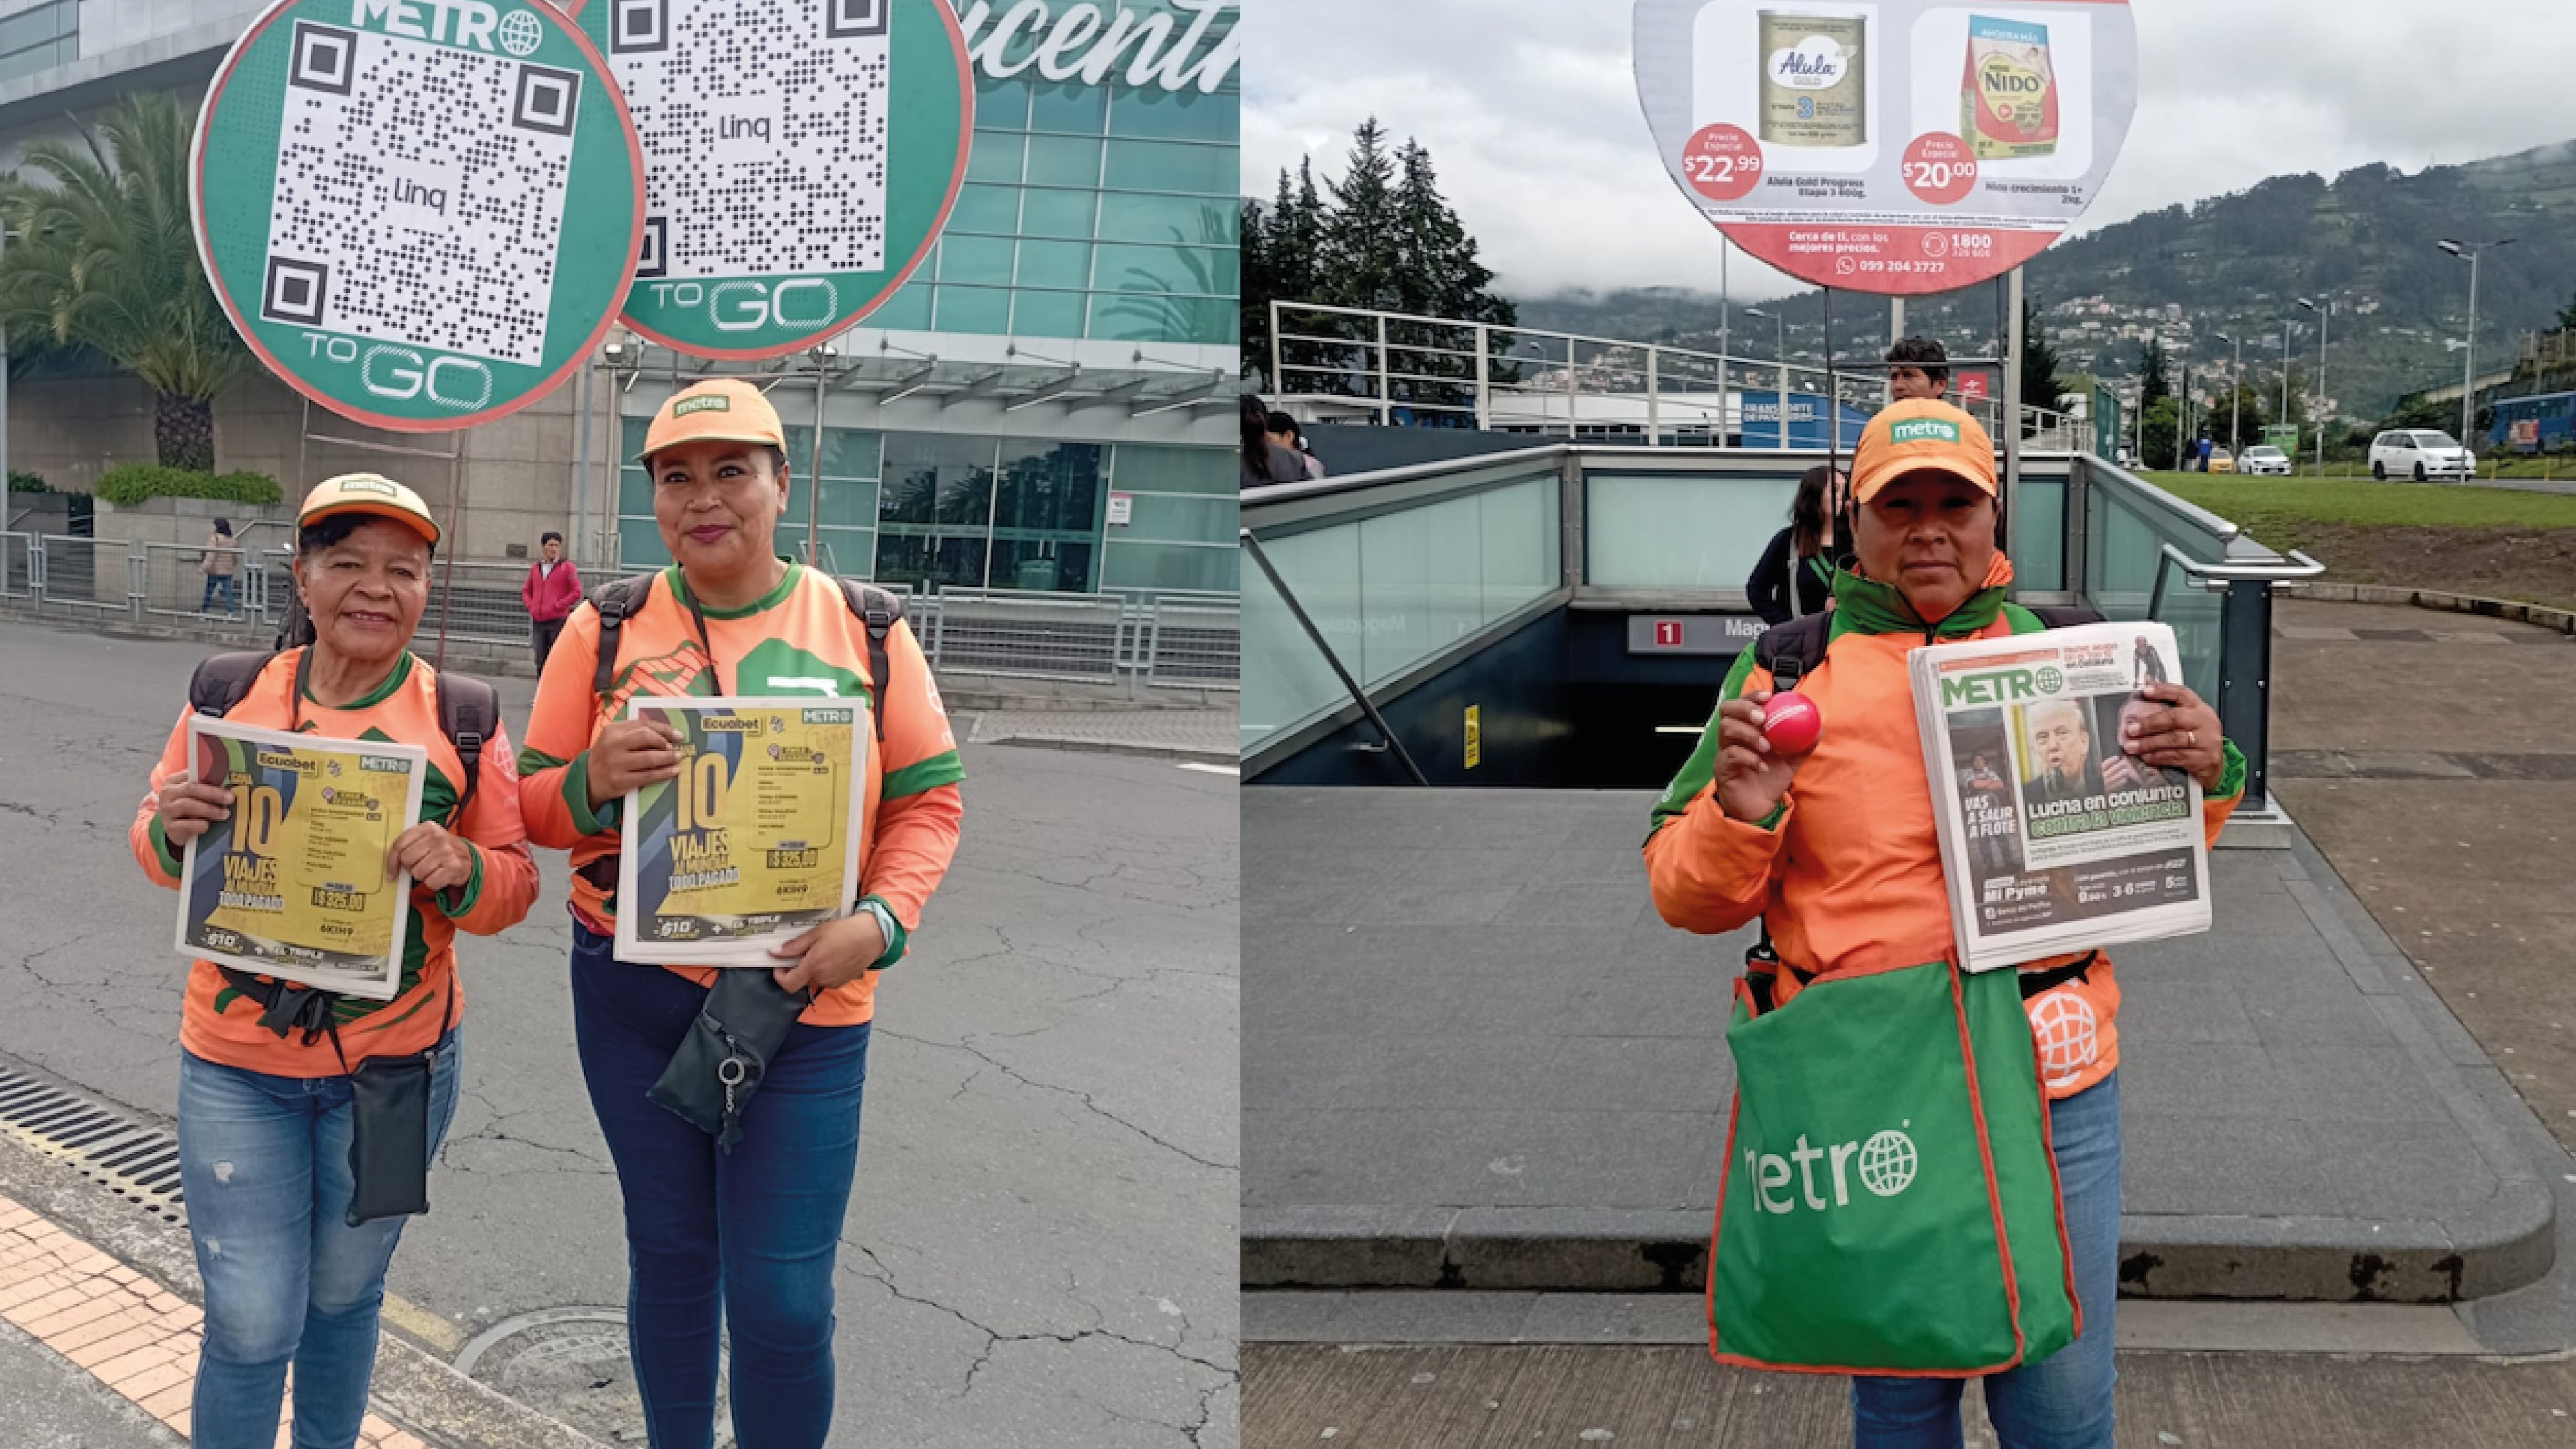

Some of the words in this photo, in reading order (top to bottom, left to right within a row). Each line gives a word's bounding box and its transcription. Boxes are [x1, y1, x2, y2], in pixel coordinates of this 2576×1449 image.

[1778, 52, 1835, 76] Alula
[1986, 72, 2039, 92] NIDO
[1797, 96, 1814, 119] 3
[719, 116, 771, 144] Linq
[1925, 140, 1955, 149] Precio
[1684, 156, 1760, 182] $22.99
[1904, 161, 1975, 187] $20.00
[1796, 177, 1819, 186] Gold
[1820, 177, 1865, 189] Progress
[1798, 188, 1827, 197] Etapa
[2011, 184, 2070, 193] crecimiento
[394, 177, 447, 214] Linq
[1789, 231, 1819, 242] Cerca
[1820, 232, 1834, 242] de
[1851, 233, 1870, 242] con
[1952, 234, 1992, 248] 1800
[1788, 243, 1834, 254] mejores
[1859, 260, 1885, 271] 099
[1886, 260, 1911, 272] 204
[1914, 261, 1945, 273] 3727
[650, 283, 703, 308] TO
[709, 279, 838, 331] GO
[301, 331, 357, 363] TO
[362, 343, 493, 411] GO
[1894, 420, 1954, 440] metro
[1661, 624, 1673, 643] 1
[1941, 665, 2063, 707] METRO
[703, 718, 759, 730] Ecuabet
[804, 710, 852, 723] METRO
[259, 753, 316, 771] Ecuabet
[361, 756, 411, 773] METRO
[678, 752, 728, 832] 10
[2028, 798, 2082, 818] Lucha
[2083, 795, 2106, 810] en
[2108, 785, 2185, 808] conjunto
[1965, 797, 1989, 811] VAS
[232, 785, 282, 857] 10
[1978, 807, 2013, 822] SALIR
[1980, 821, 2015, 836] FLOTE
[669, 832, 730, 861] VIAJES
[223, 855, 279, 881] VIAJES
[2005, 884, 2048, 901] Pyme
